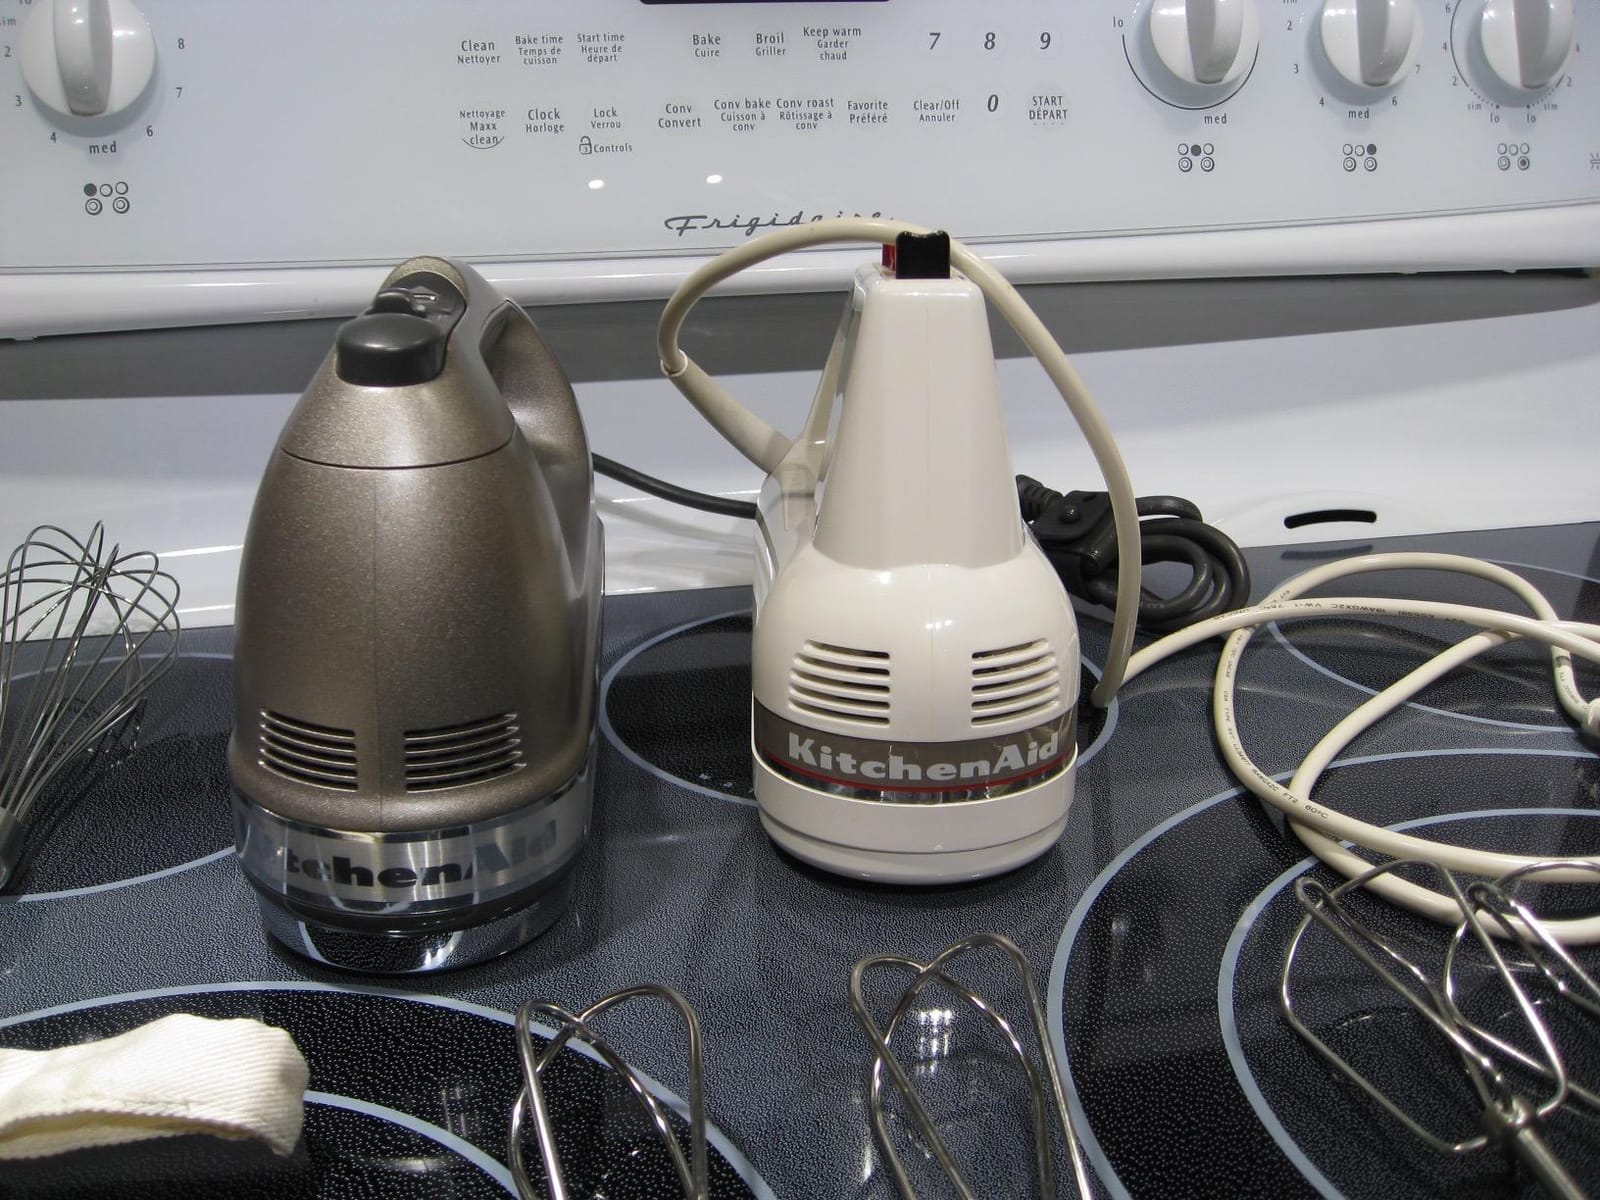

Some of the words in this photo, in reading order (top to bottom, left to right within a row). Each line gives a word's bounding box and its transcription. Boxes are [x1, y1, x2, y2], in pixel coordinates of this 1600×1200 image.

[1287, 20, 1293, 31] 2
[576, 33, 600, 43] Start
[603, 31, 625, 43] time
[756, 31, 784, 45] Broil
[803, 26, 829, 39] Keep
[832, 27, 862, 37] warm
[177, 37, 185, 50] 8
[515, 34, 538, 45] Bake
[541, 34, 564, 44] time
[692, 32, 721, 46] Bake
[816, 38, 849, 49] Garder
[929, 32, 941, 51] 7
[983, 31, 996, 51] 8
[1039, 31, 1051, 50] 9
[3, 45, 12, 58] 2
[461, 39, 495, 52] Clean
[518, 47, 547, 57] Temps
[550, 45, 562, 55] de
[580, 45, 609, 54] Heure
[611, 44, 623, 53] de
[755, 45, 786, 57] Griller
[694, 47, 720, 58] Cuire
[819, 50, 847, 61] chaud
[457, 54, 501, 65] Nettoyer
[523, 57, 558, 66] cuisson
[1293, 63, 1299, 74] 3
[1415, 63, 1421, 74] 7
[1452, 75, 1458, 87] 2
[175, 86, 183, 98] 7
[15, 94, 22, 107] 3
[713, 99, 741, 110] Conv
[744, 97, 771, 109] bake
[776, 97, 803, 109] Conv
[806, 97, 834, 108] roast
[847, 100, 889, 111] Favorite
[913, 98, 960, 111] Clear/Off
[987, 94, 999, 113] 0
[1032, 95, 1063, 107] START
[1319, 96, 1325, 107] 4
[1391, 95, 1398, 106] 6
[1467, 102, 1482, 111] sim
[1543, 102, 1558, 111] sim
[459, 109, 506, 120] Nettoyage
[527, 107, 561, 121] Clock
[593, 106, 618, 119] Lock
[665, 103, 692, 114] Conv
[1028, 106, 1068, 121] DÉPART
[1348, 107, 1370, 119] med
[720, 111, 756, 122] Cuisson
[919, 111, 955, 122] Annuler
[1203, 112, 1227, 125] med
[1489, 111, 1501, 124] lo
[1526, 111, 1537, 124] lo
[469, 121, 497, 132] Maxx
[525, 122, 565, 135] Horloge
[590, 120, 621, 129] Verrou
[658, 117, 701, 129] Convert
[732, 123, 755, 132] conv
[795, 121, 818, 130] conv
[146, 124, 154, 137] 6
[49, 131, 57, 143] 4
[469, 133, 499, 146] clean
[88, 140, 117, 155] med
[593, 142, 633, 153] Controls
[664, 210, 885, 237] Frigidae
[788, 732, 1059, 781] KitchenAid
